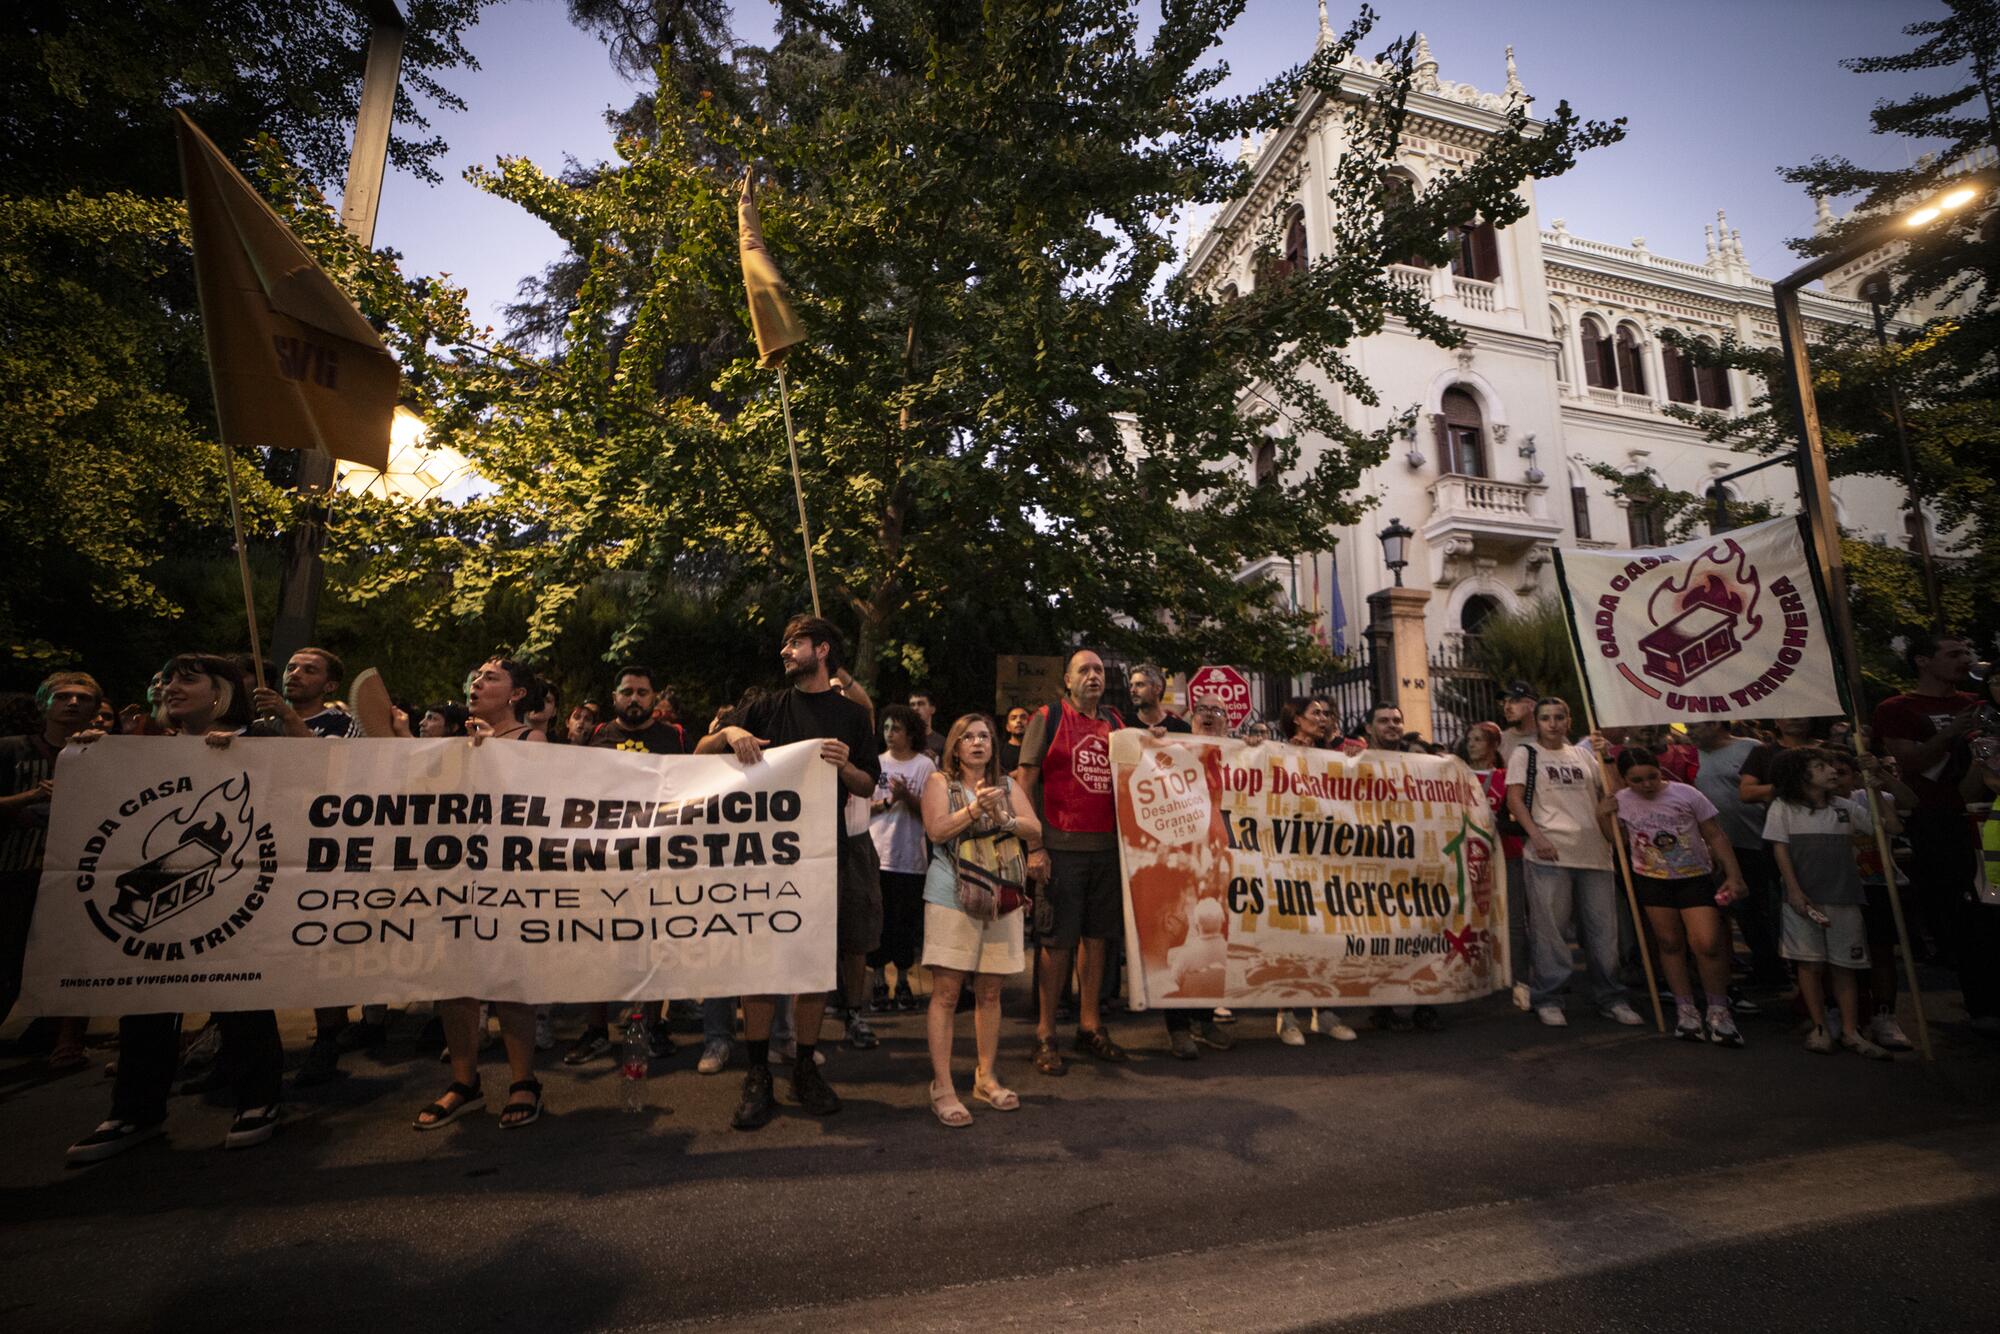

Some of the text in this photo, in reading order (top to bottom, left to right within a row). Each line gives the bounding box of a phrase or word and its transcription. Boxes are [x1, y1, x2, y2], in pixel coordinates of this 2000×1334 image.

[1595, 554, 1680, 658] CADA CASA
[1666, 575, 1809, 713] UNA TRINCHERA
[1192, 683, 1246, 702] STOP
[1078, 750, 1108, 767] STO
[1136, 768, 1198, 805] STOP
[1271, 765, 1398, 802] Desahucios
[308, 789, 801, 830] CONTRA EL BENEFICIO
[1154, 809, 1205, 832] Granada
[77, 776, 194, 893] CADA CASA
[1172, 824, 1196, 838] 15 M
[1222, 809, 1415, 859] La vivienda
[306, 830, 801, 874] DE LOS RENTISTAS
[122, 822, 278, 962] UNA TRINCHERA
[297, 880, 802, 912] ORGANÍZATE Y LUCHA
[1227, 876, 1264, 914] es
[1274, 878, 1316, 917] un
[1324, 875, 1451, 918] derecho
[291, 910, 802, 947] CON TU SINDICATO
[1345, 934, 1365, 957] No
[1371, 936, 1389, 956] un
[1395, 934, 1451, 958] negocio
[60, 977, 115, 988] SINDICATO
[117, 976, 132, 987] DE
[136, 974, 189, 986] VIVIENDA
[208, 972, 262, 983] GRANADA
